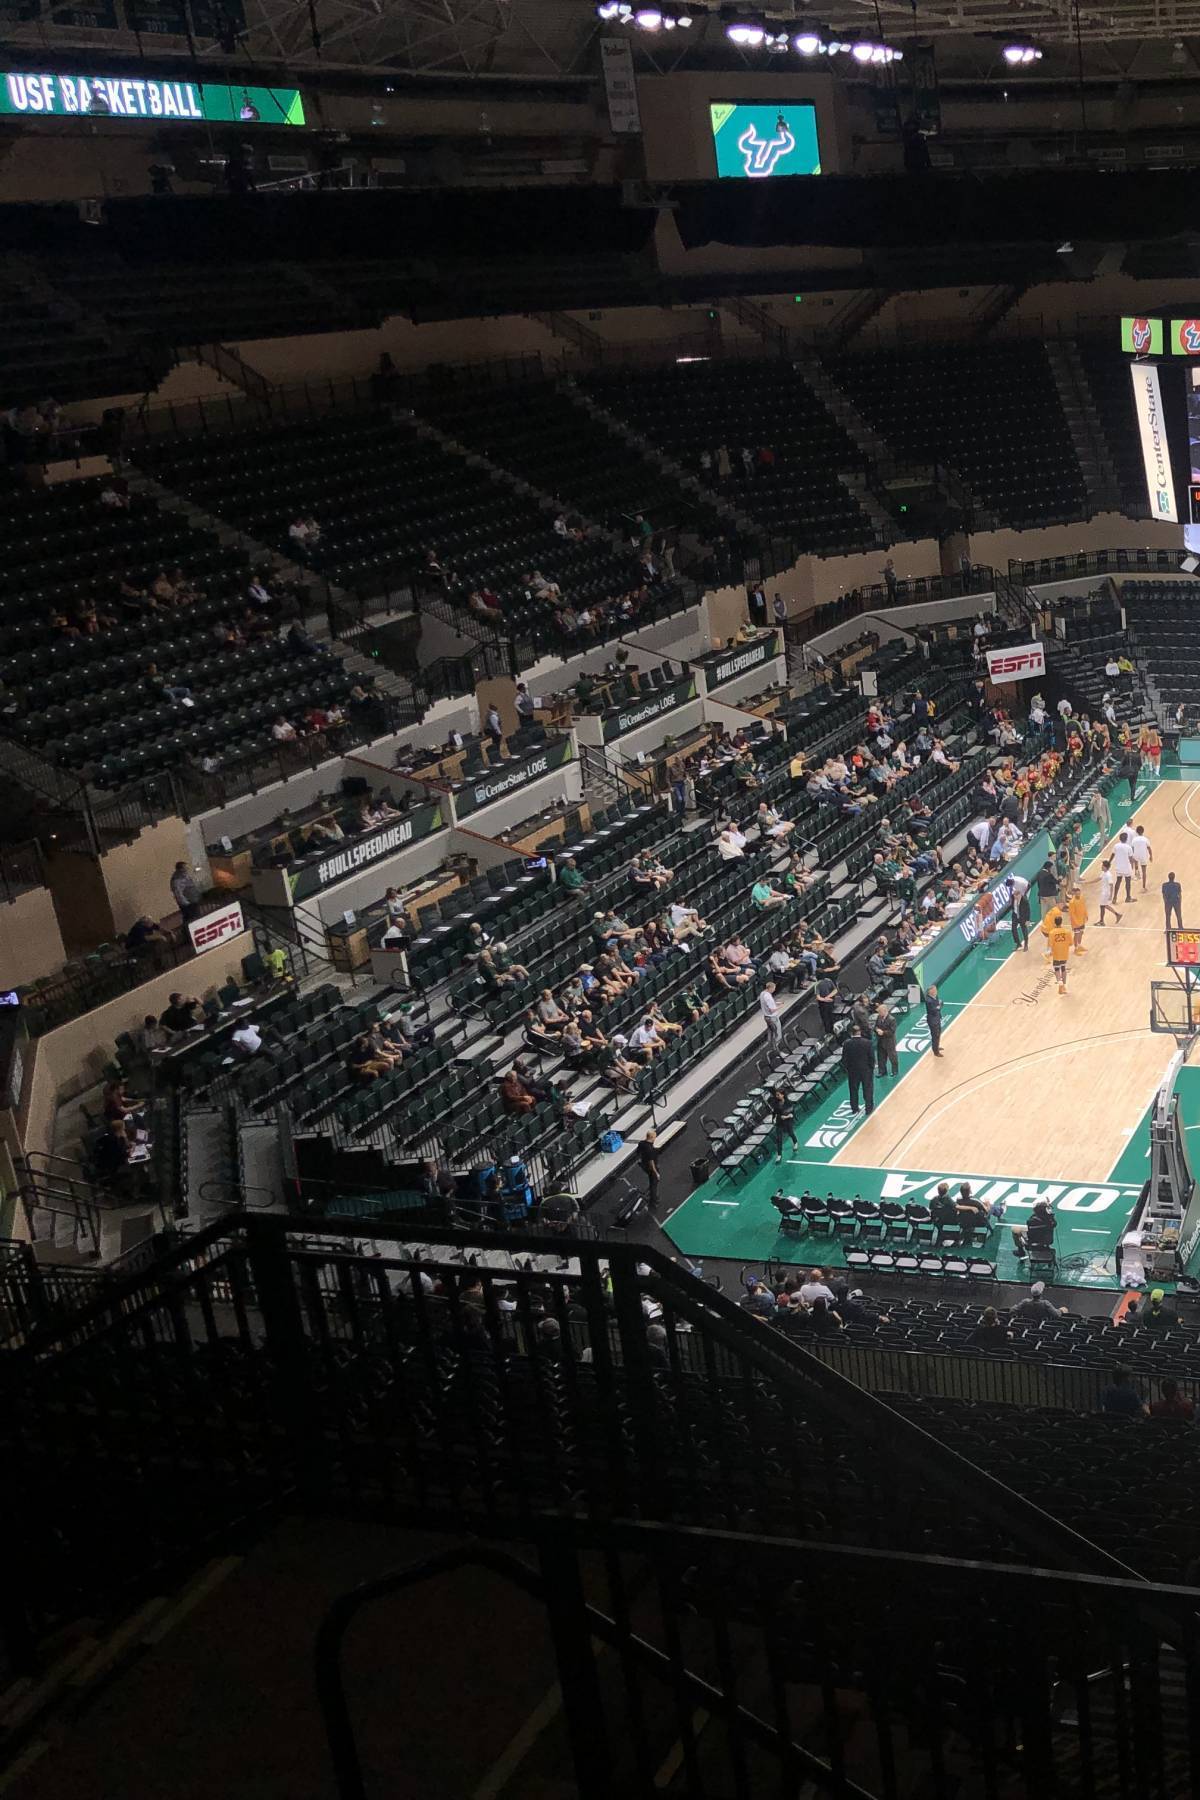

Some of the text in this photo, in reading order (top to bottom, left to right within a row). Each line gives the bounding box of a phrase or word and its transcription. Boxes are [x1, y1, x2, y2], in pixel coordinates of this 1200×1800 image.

[9, 73, 202, 118] USF BASKETBALL
[1146, 376, 1167, 488] CenterState
[991, 652, 1042, 675] ESPN
[660, 693, 677, 711] LOGE
[485, 757, 548, 798] CenterState LOGE
[318, 821, 412, 883] #BULLSPEEDAHEAD
[194, 912, 240, 947] ESPN
[1055, 932, 1066, 943] 23
